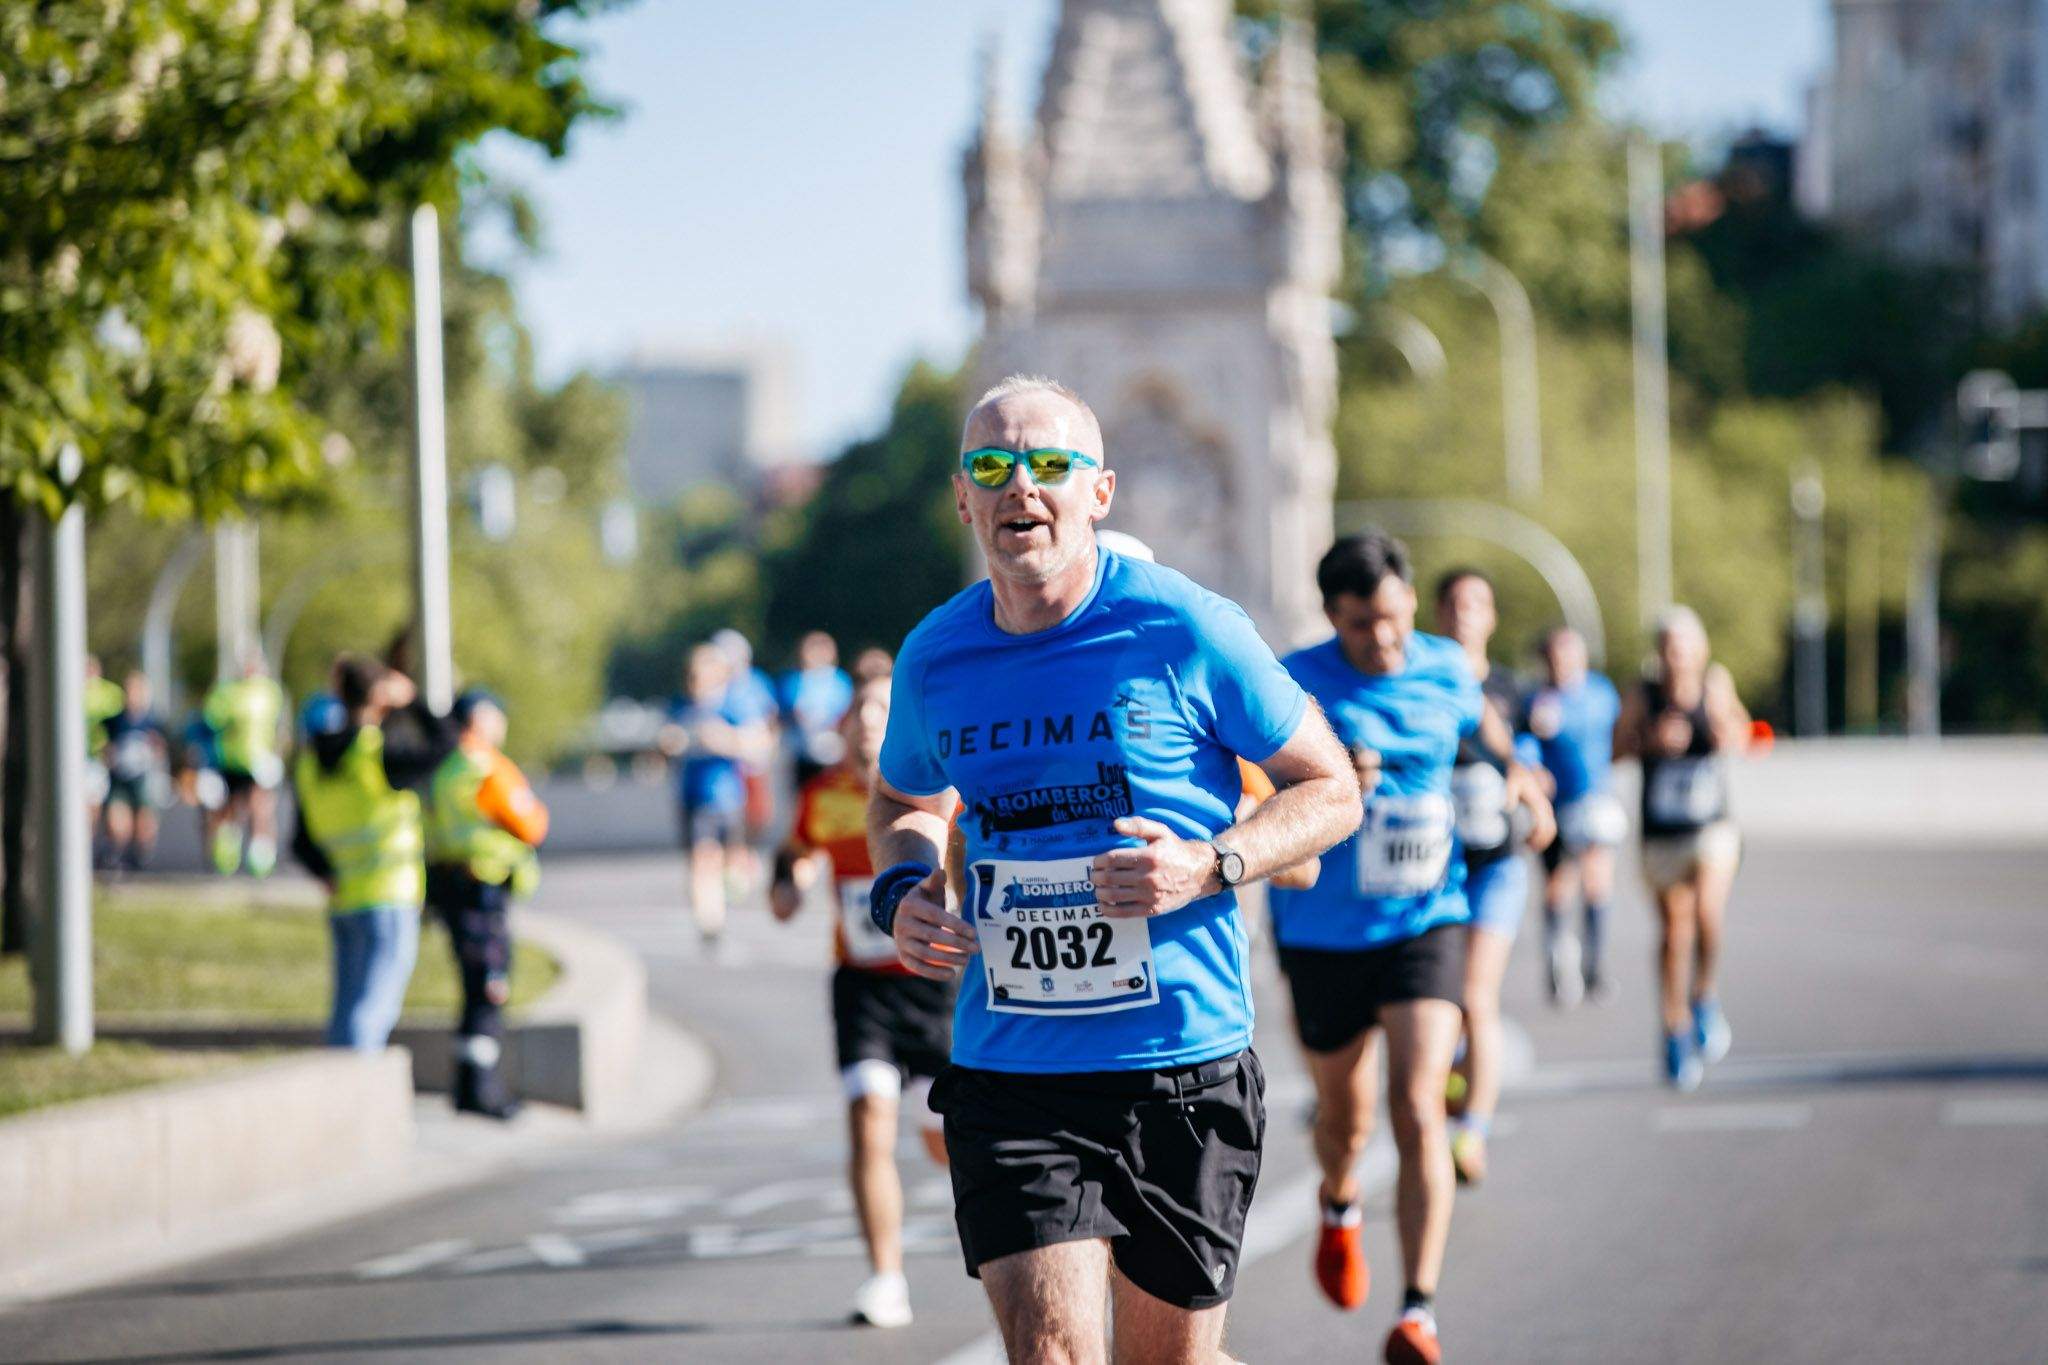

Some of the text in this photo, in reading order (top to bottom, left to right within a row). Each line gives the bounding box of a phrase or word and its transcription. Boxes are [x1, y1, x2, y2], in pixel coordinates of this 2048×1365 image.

[938, 711, 1150, 759] DECIMAS
[997, 784, 1125, 815] BOMBEROS
[1022, 881, 1095, 896] BOMBERO
[1006, 922, 1117, 970] 2032
